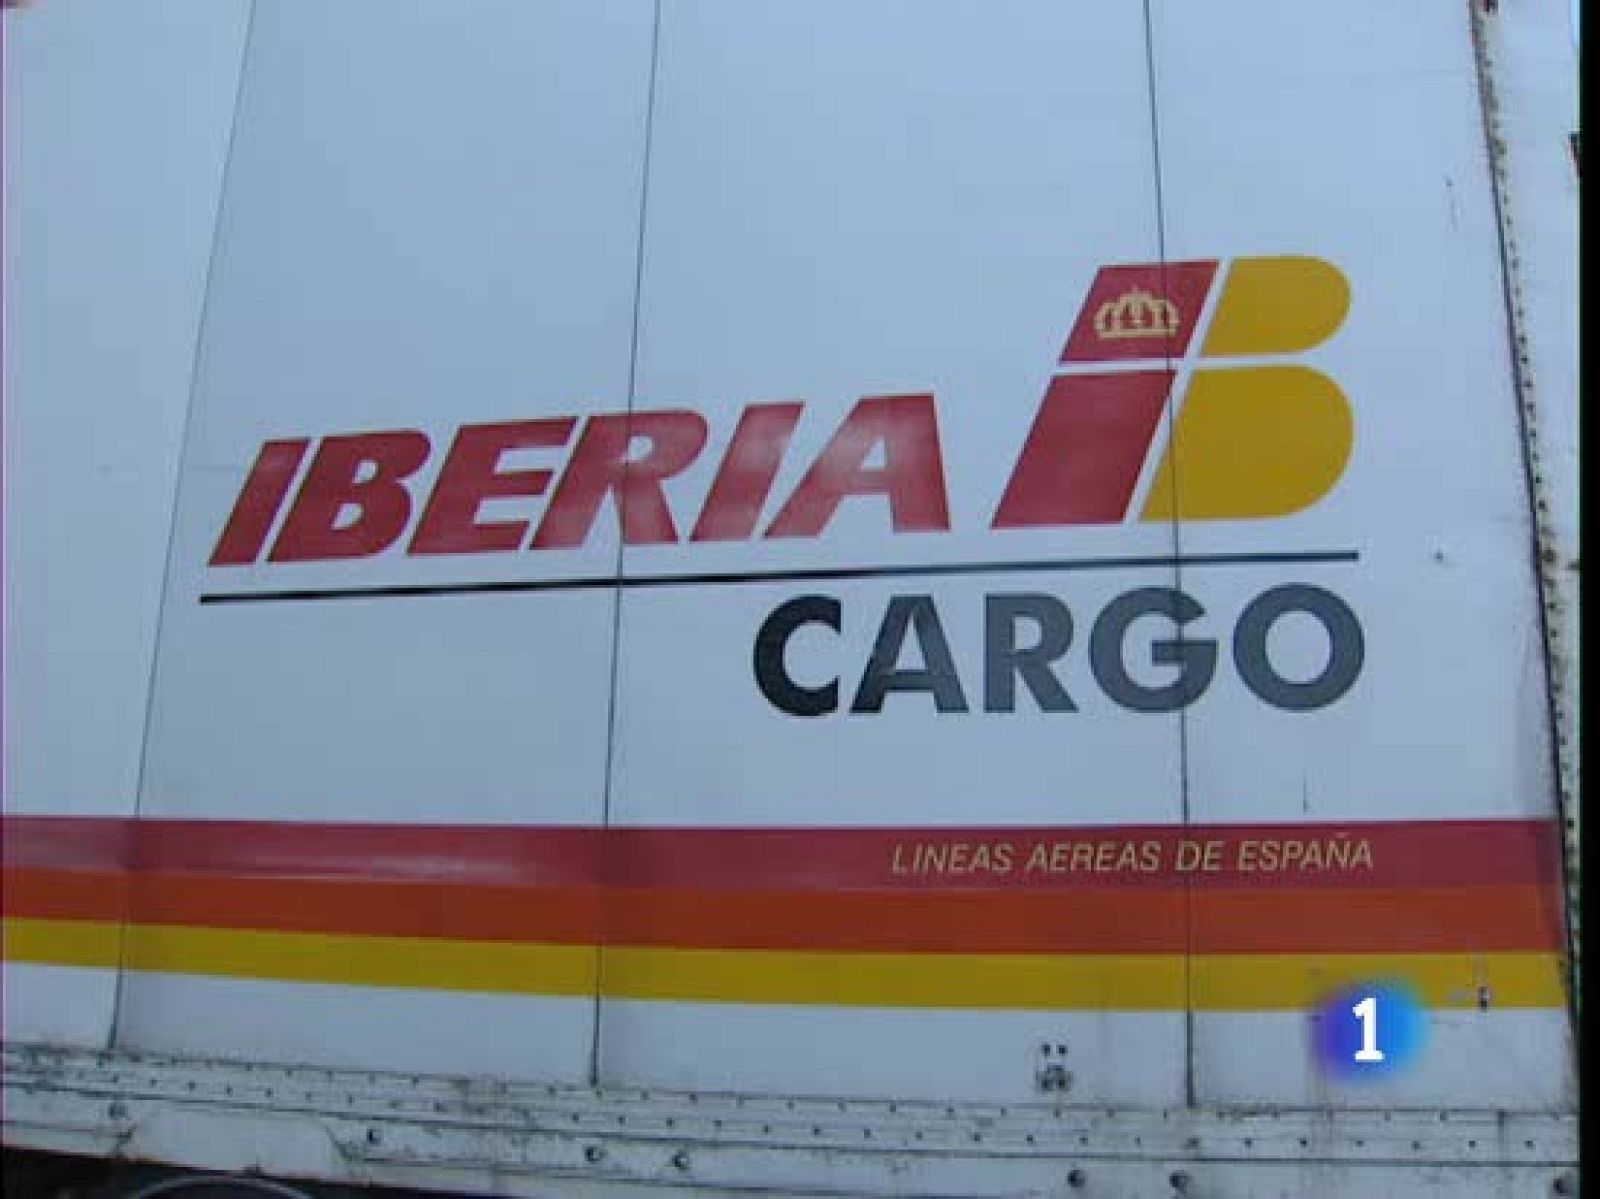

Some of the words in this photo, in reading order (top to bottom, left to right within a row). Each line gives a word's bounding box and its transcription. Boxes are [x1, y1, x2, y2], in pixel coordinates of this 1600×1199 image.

[207, 393, 951, 566] IBERIA
[752, 583, 1366, 717] CARGO
[892, 843, 1013, 875] LINEAS
[1025, 842, 1162, 873] AEREAS
[1175, 840, 1221, 872] DE
[1238, 833, 1373, 871] ESPAÑA
